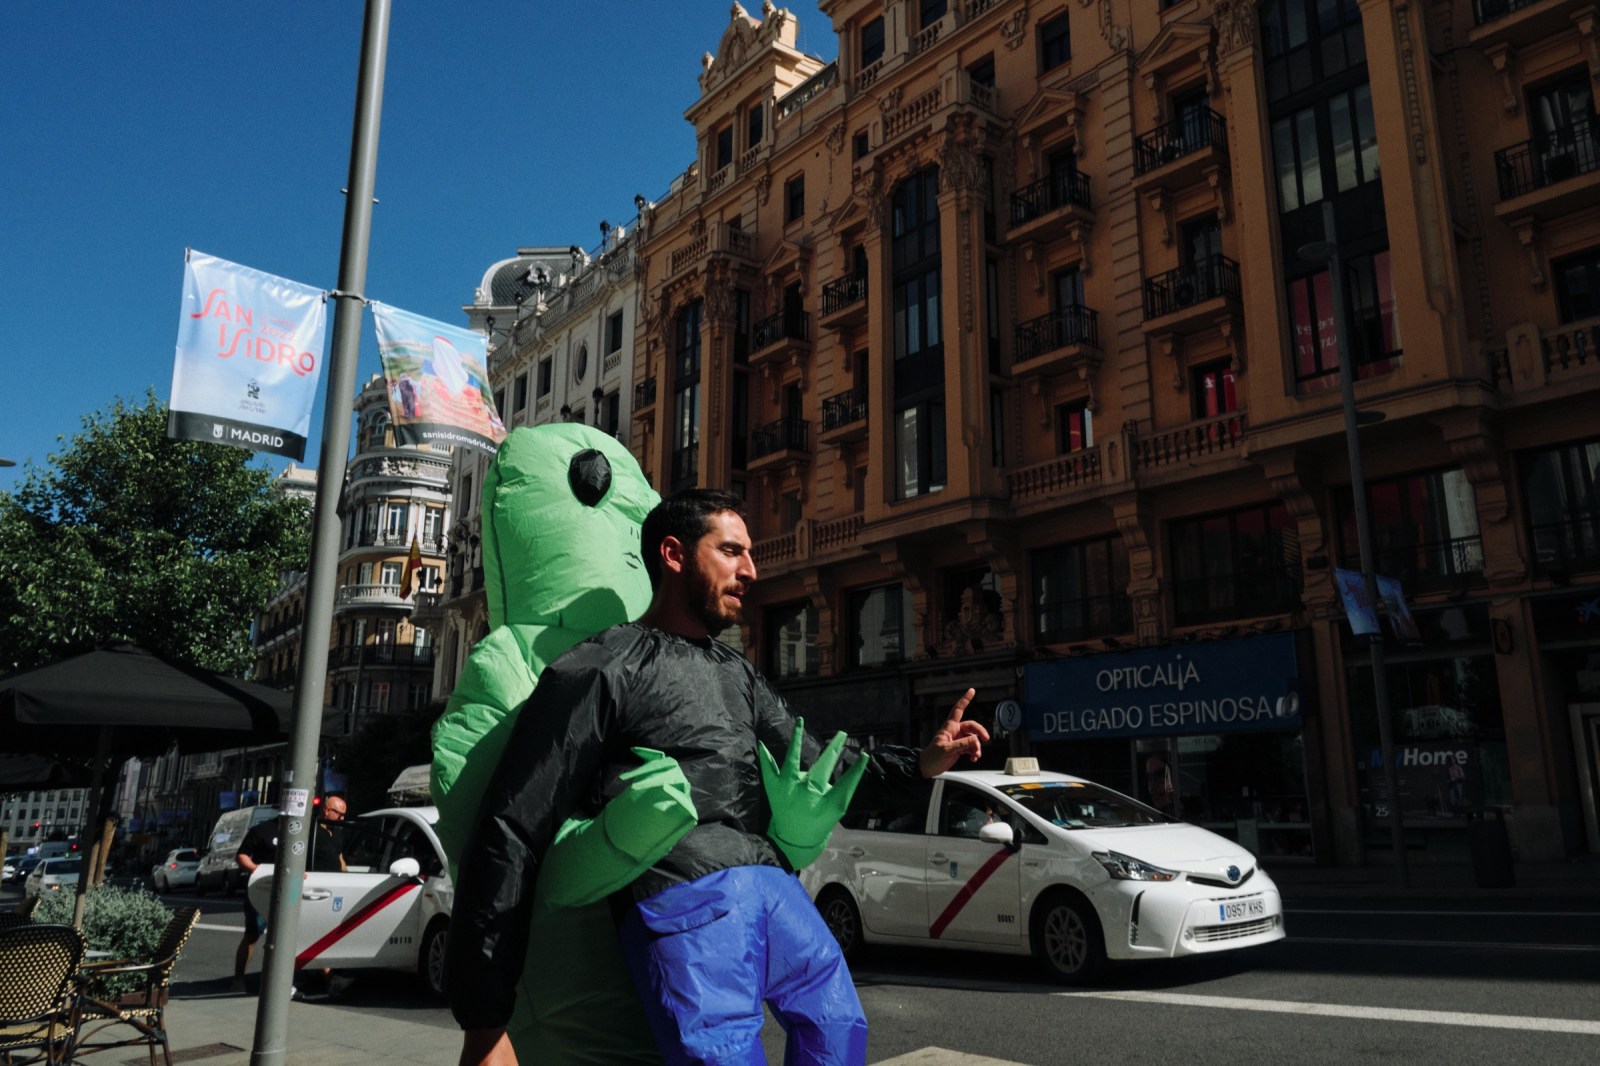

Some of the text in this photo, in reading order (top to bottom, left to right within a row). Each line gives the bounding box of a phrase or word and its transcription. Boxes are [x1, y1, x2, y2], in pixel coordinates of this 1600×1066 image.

[190, 288, 253, 326] SAN
[217, 322, 315, 377] ISIDRO
[231, 428, 284, 448] MADRID
[1043, 704, 1143, 734] DELGADO
[1149, 696, 1273, 727] ESPINOSA
[1226, 901, 1263, 918] 0957 KHS
